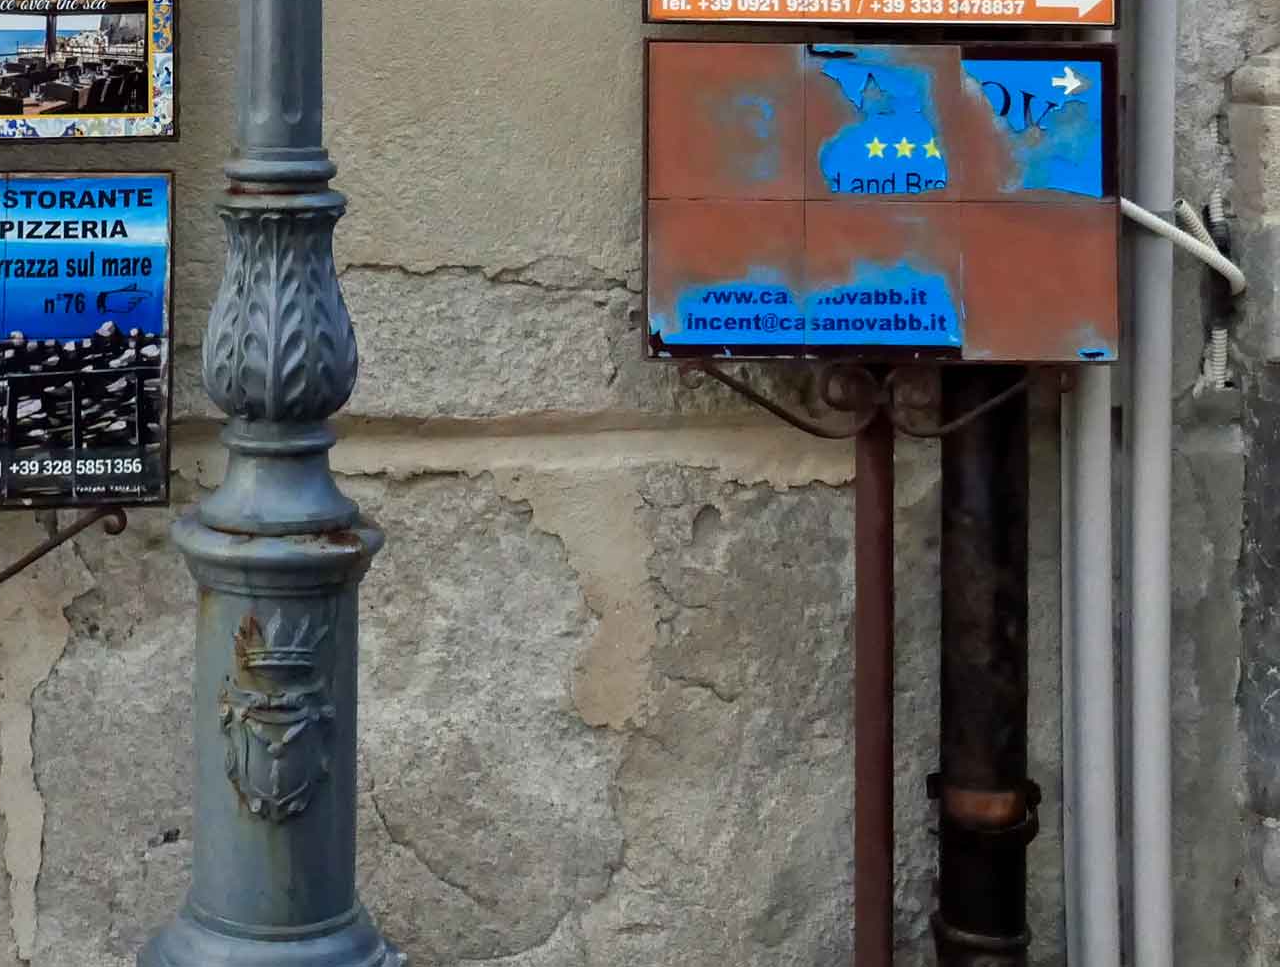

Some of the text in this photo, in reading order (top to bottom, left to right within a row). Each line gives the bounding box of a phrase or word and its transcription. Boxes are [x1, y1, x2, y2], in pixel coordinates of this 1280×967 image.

[869, 0, 904, 15] +39
[910, 0, 943, 14] 333
[948, 0, 1025, 15] 3478837
[851, 172, 896, 194] and
[0, 221, 128, 239] PIZZERIA
[65, 251, 96, 278] sul
[101, 257, 152, 277] mare
[9, 460, 40, 475] +39
[43, 459, 72, 476] 328
[76, 458, 142, 475] 5851356
